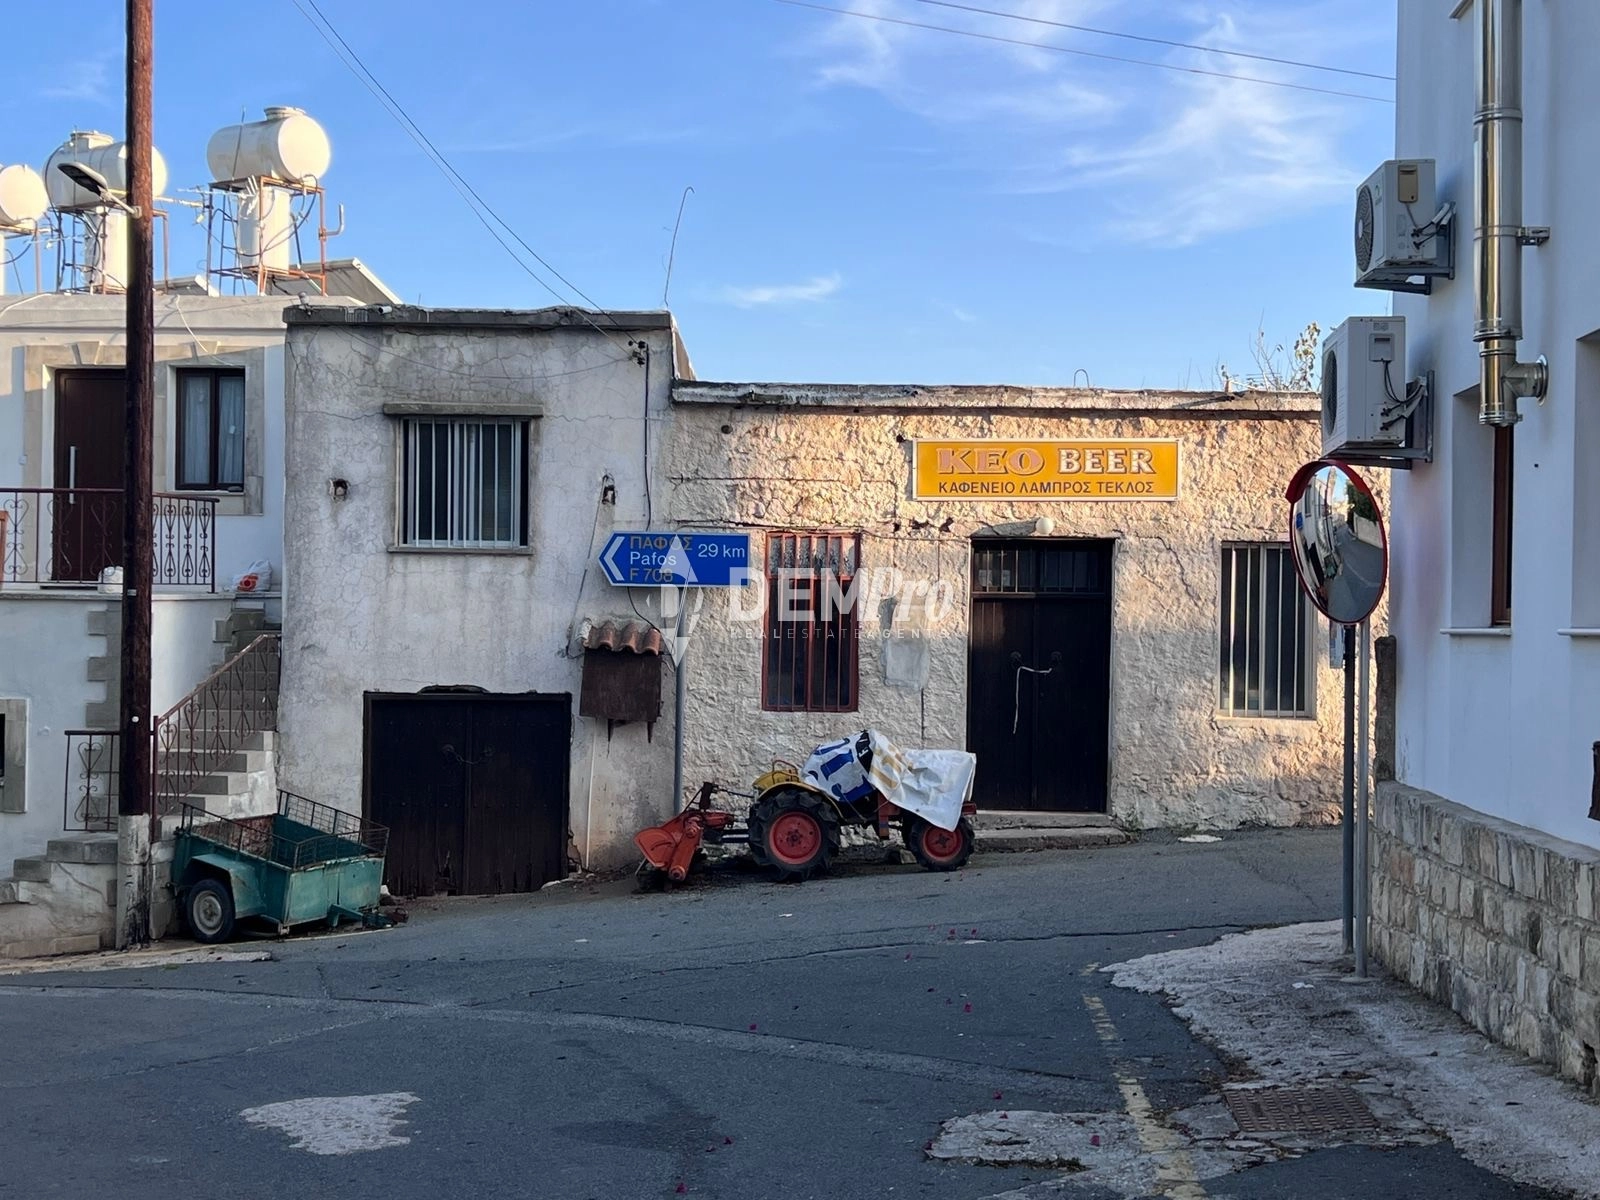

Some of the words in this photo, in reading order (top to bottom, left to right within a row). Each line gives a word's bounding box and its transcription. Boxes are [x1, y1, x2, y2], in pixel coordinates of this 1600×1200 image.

[936, 447, 1044, 475] KEO
[1057, 447, 1156, 475] BEER
[938, 480, 1015, 494] ΚΑΦΕΝΕΙΟ
[1019, 480, 1092, 494] ΛΑΜΠΡΟΣ
[1097, 480, 1154, 494] ΤΕΚΛΟΣ
[630, 536, 693, 551] ΠΑΦΟΣ
[698, 543, 719, 558] 29
[723, 544, 746, 558] km
[630, 552, 677, 566] Pafos
[630, 568, 638, 581] F
